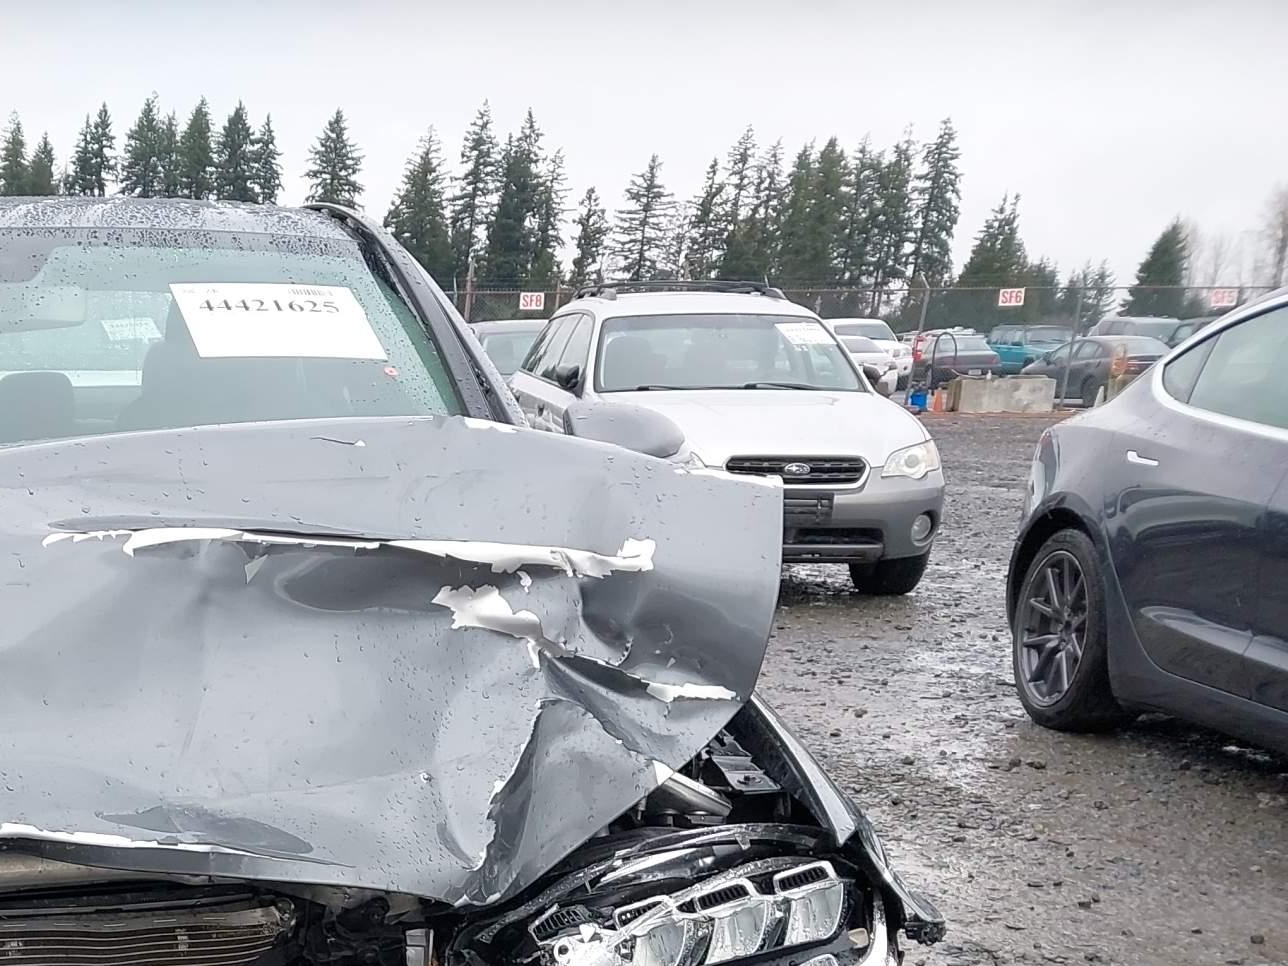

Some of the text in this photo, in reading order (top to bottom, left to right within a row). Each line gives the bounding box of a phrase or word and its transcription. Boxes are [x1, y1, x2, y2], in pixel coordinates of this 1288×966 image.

[522, 294, 543, 308] SF8
[1001, 290, 1024, 304] SF6
[199, 298, 340, 314] 44421625
